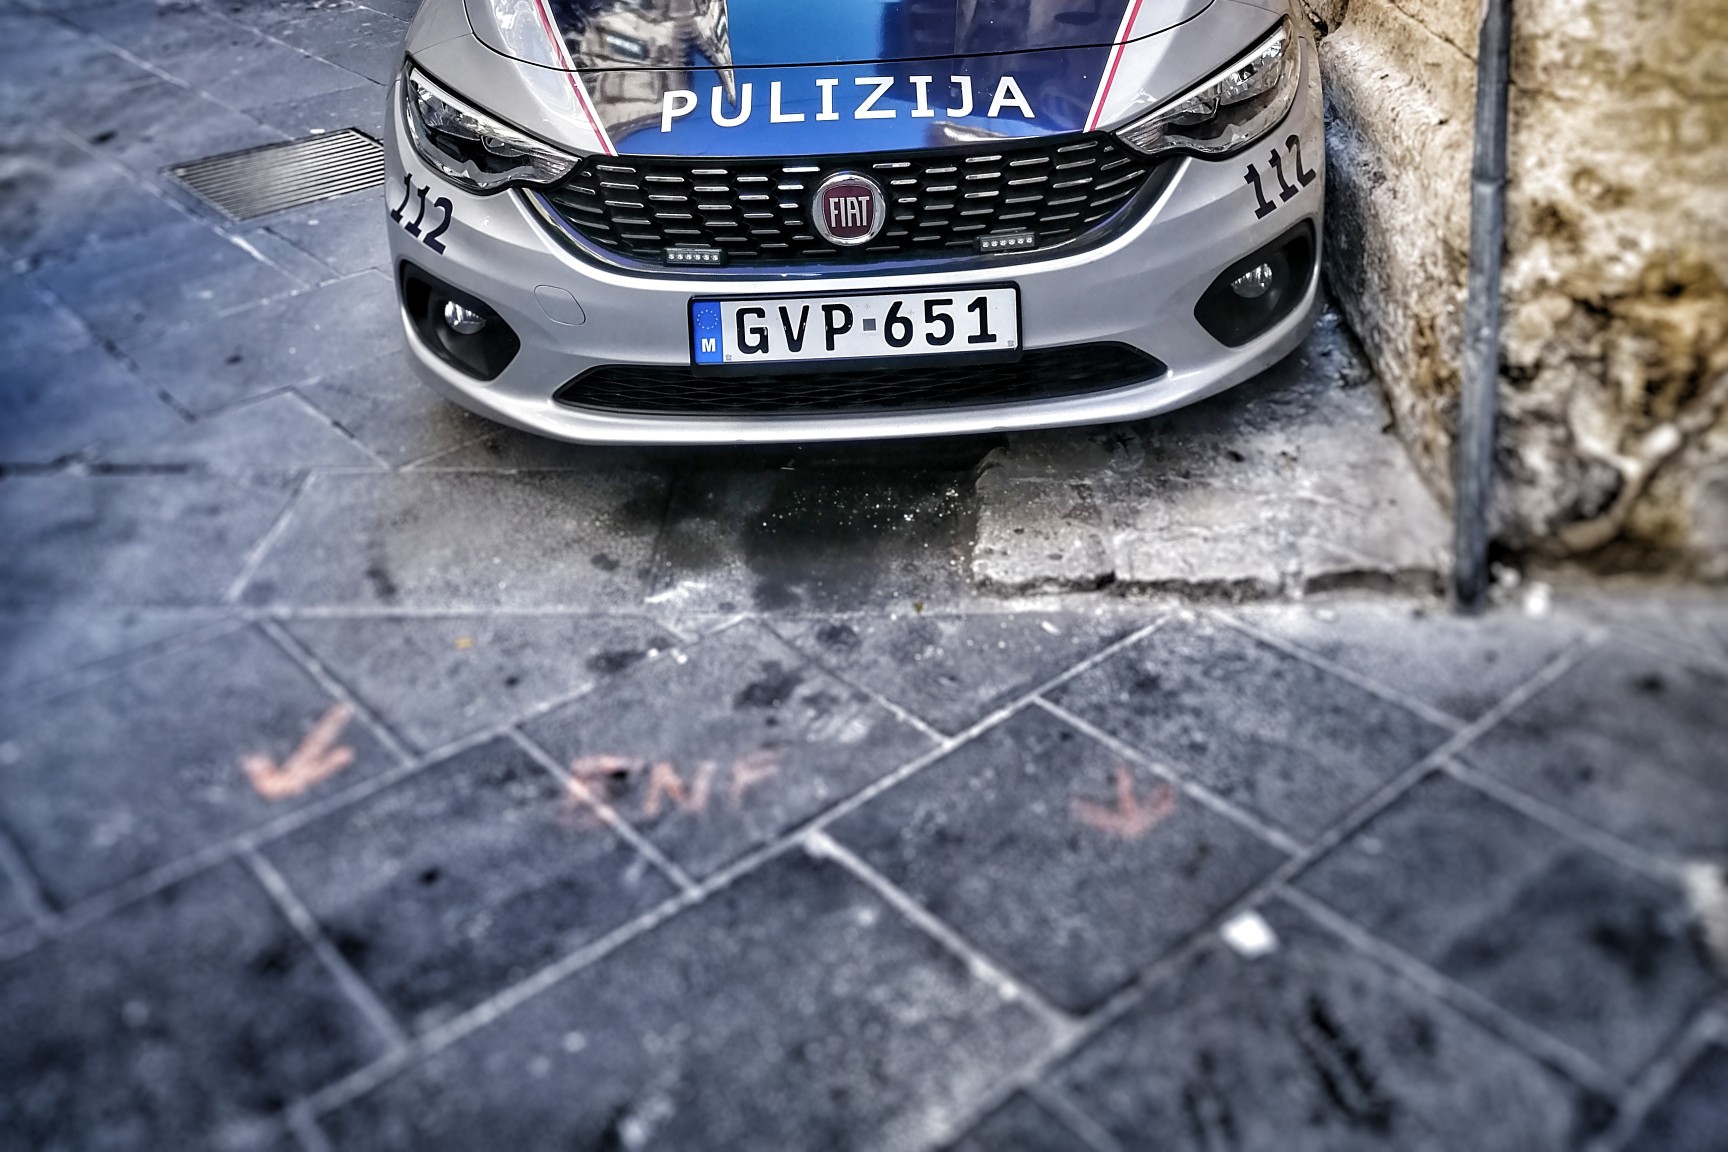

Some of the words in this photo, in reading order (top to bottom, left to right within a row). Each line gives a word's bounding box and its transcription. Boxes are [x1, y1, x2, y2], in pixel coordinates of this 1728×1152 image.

[659, 74, 1036, 133] PULIZIJA
[1243, 134, 1317, 220] 112
[390, 172, 453, 256] 112
[829, 195, 873, 228] FIAT
[701, 337, 716, 353] M
